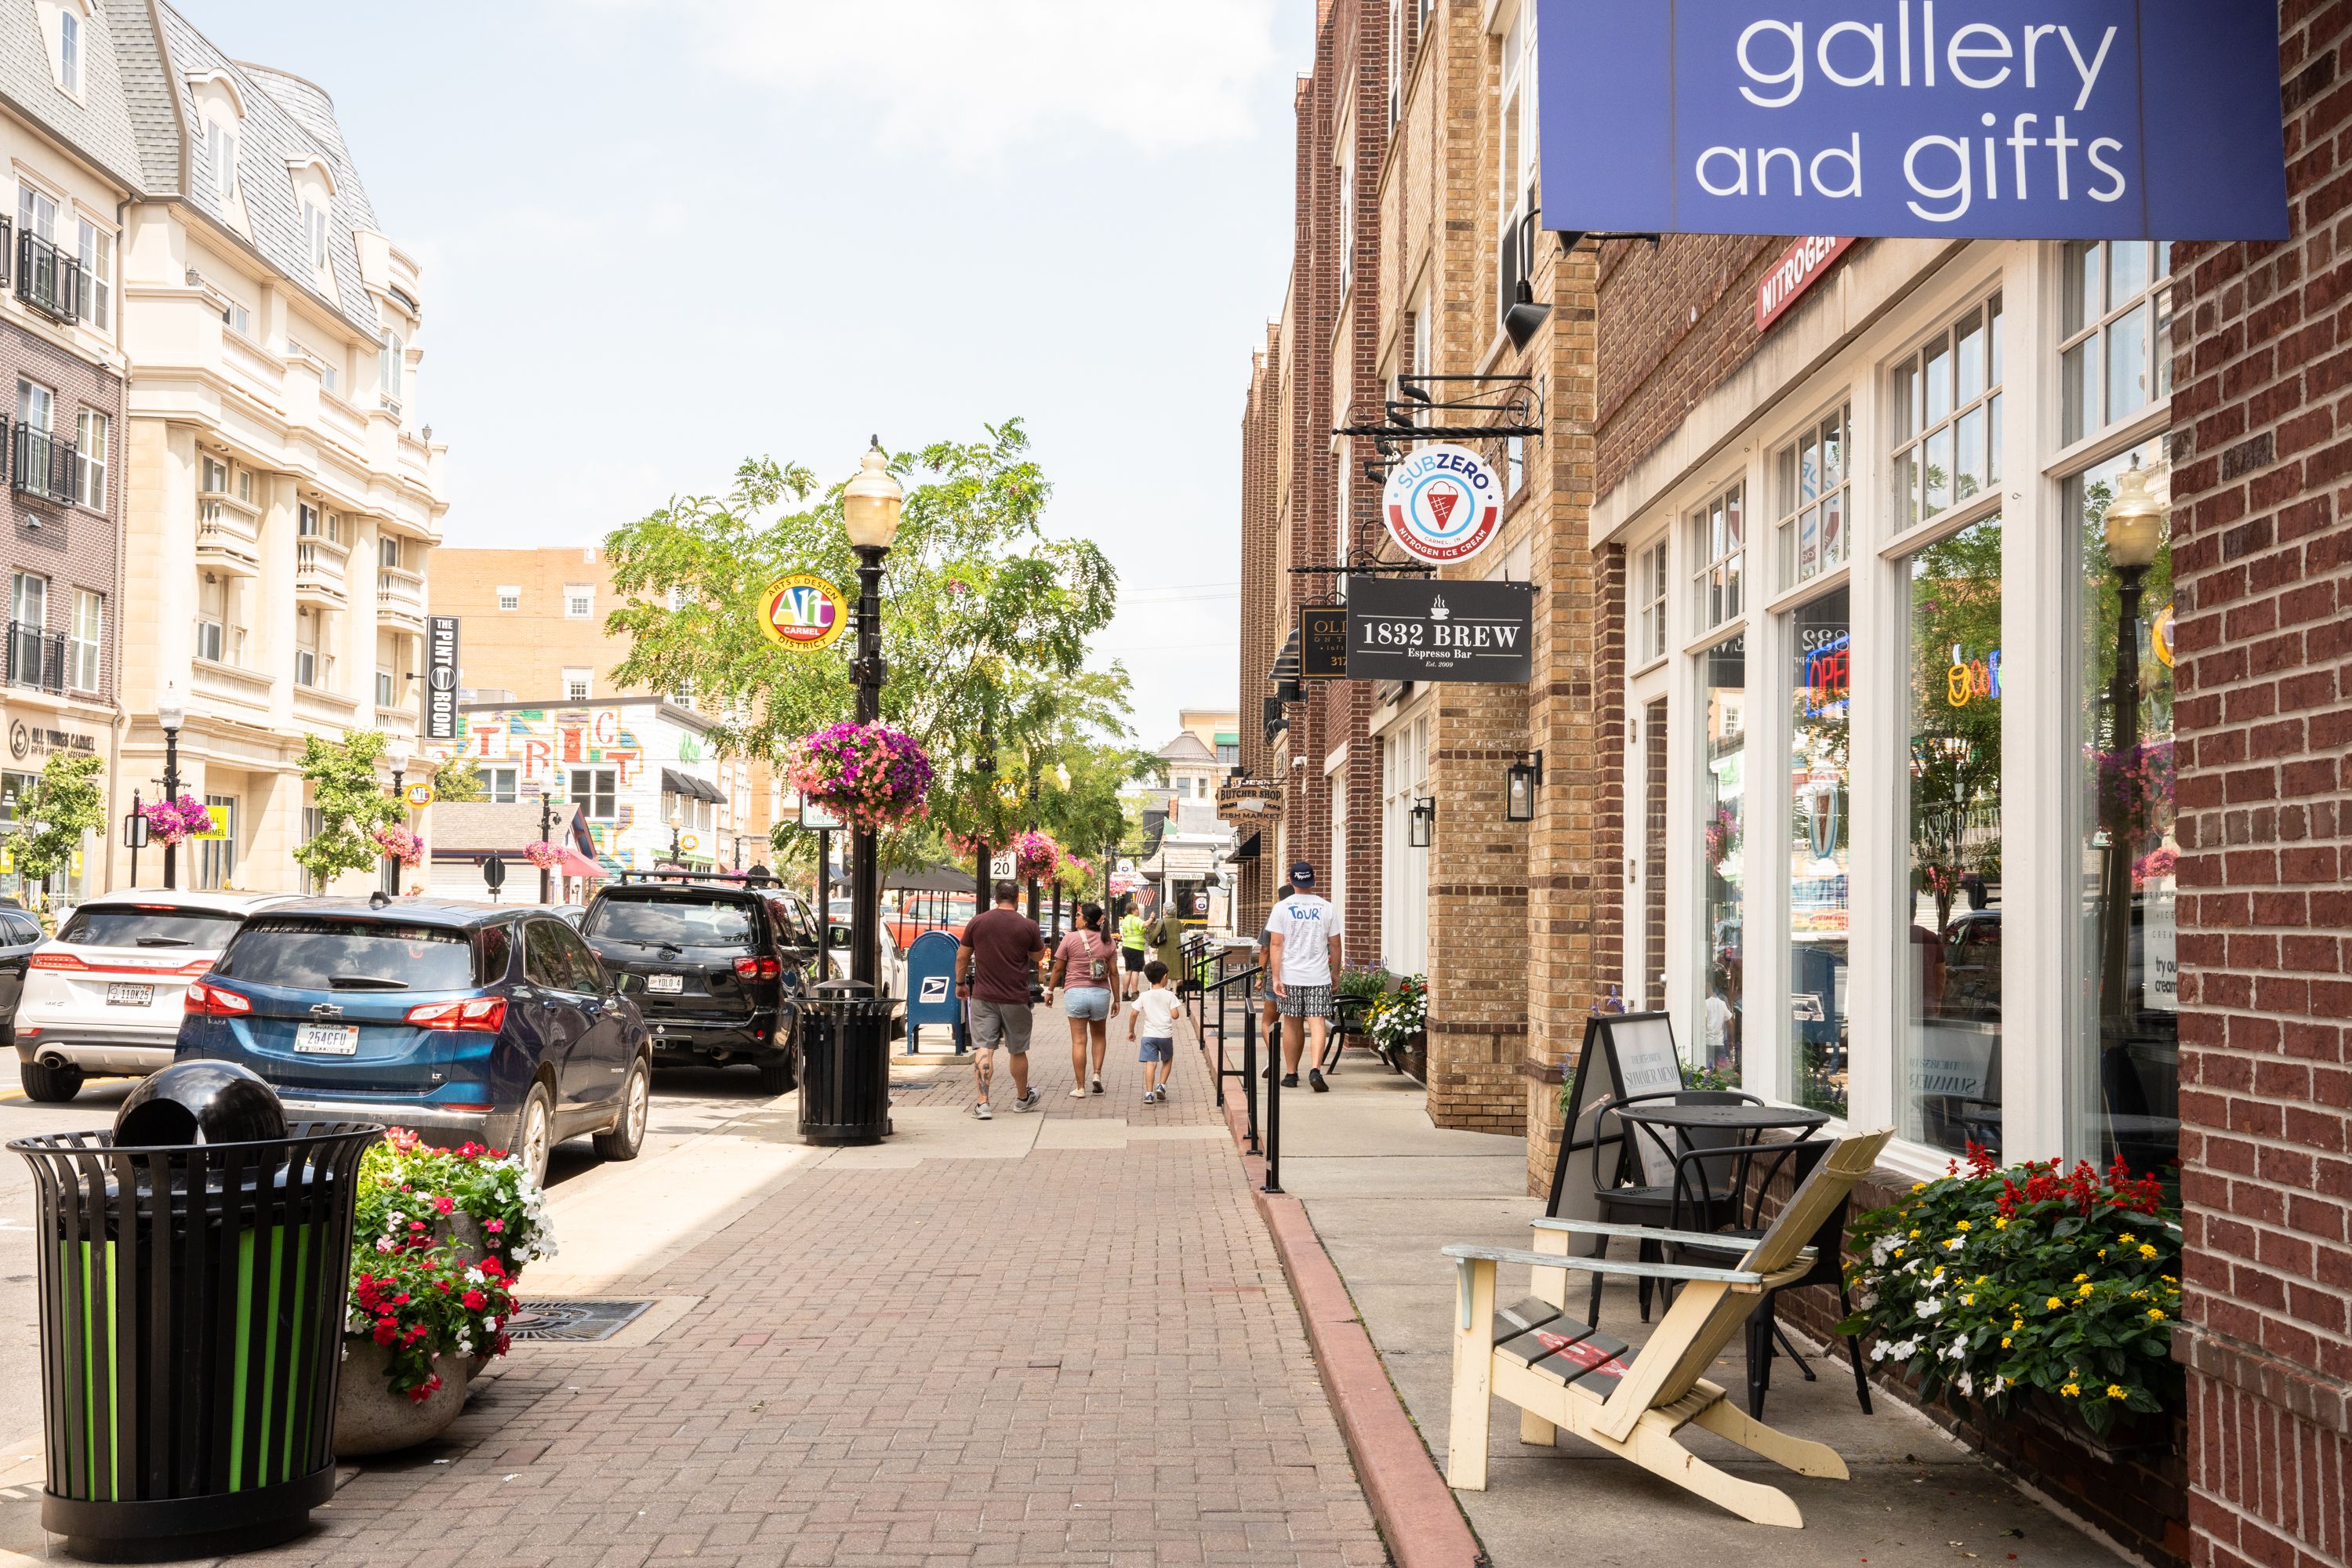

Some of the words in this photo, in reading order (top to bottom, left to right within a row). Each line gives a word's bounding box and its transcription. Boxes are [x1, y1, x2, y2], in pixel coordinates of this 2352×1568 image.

[1736, 0, 2118, 111] gallery
[1695, 132, 1863, 198] and
[1903, 111, 2126, 223] gifts
[1762, 236, 1836, 319] NITROGEN
[1399, 527, 1439, 557] NITROGEN
[1460, 529, 1487, 554] CREAM
[768, 579, 791, 597] ARTS
[804, 578, 838, 601] DESIGN
[771, 587, 834, 628] Art
[436, 619, 453, 630] THE
[784, 626, 820, 636] CARMEL
[1363, 622, 1424, 646] 1832
[1433, 624, 1520, 648] BREW
[434, 630, 453, 666] PINT
[778, 636, 827, 650] DISTRICT
[1407, 648, 1450, 659] Espresso
[1454, 649, 1472, 659] Bar
[433, 691, 452, 737] ROOM
[31, 728, 44, 745] ALL
[46, 729, 69, 747] THINGS
[71, 733, 96, 752] CARMEL
[1220, 789, 1257, 800] BUTCHER
[1259, 790, 1281, 800] SHOP
[993, 862, 1010, 875] 20
[1288, 906, 1320, 920] TOUR
[2156, 956, 2166, 978] try
[2167, 962, 2178, 973] ou
[659, 978, 673, 987] YOLO
[307, 1031, 347, 1046] 254CFU
[1624, 1069, 1657, 1087] SUMMER
[1657, 1065, 1679, 1083] MENU
